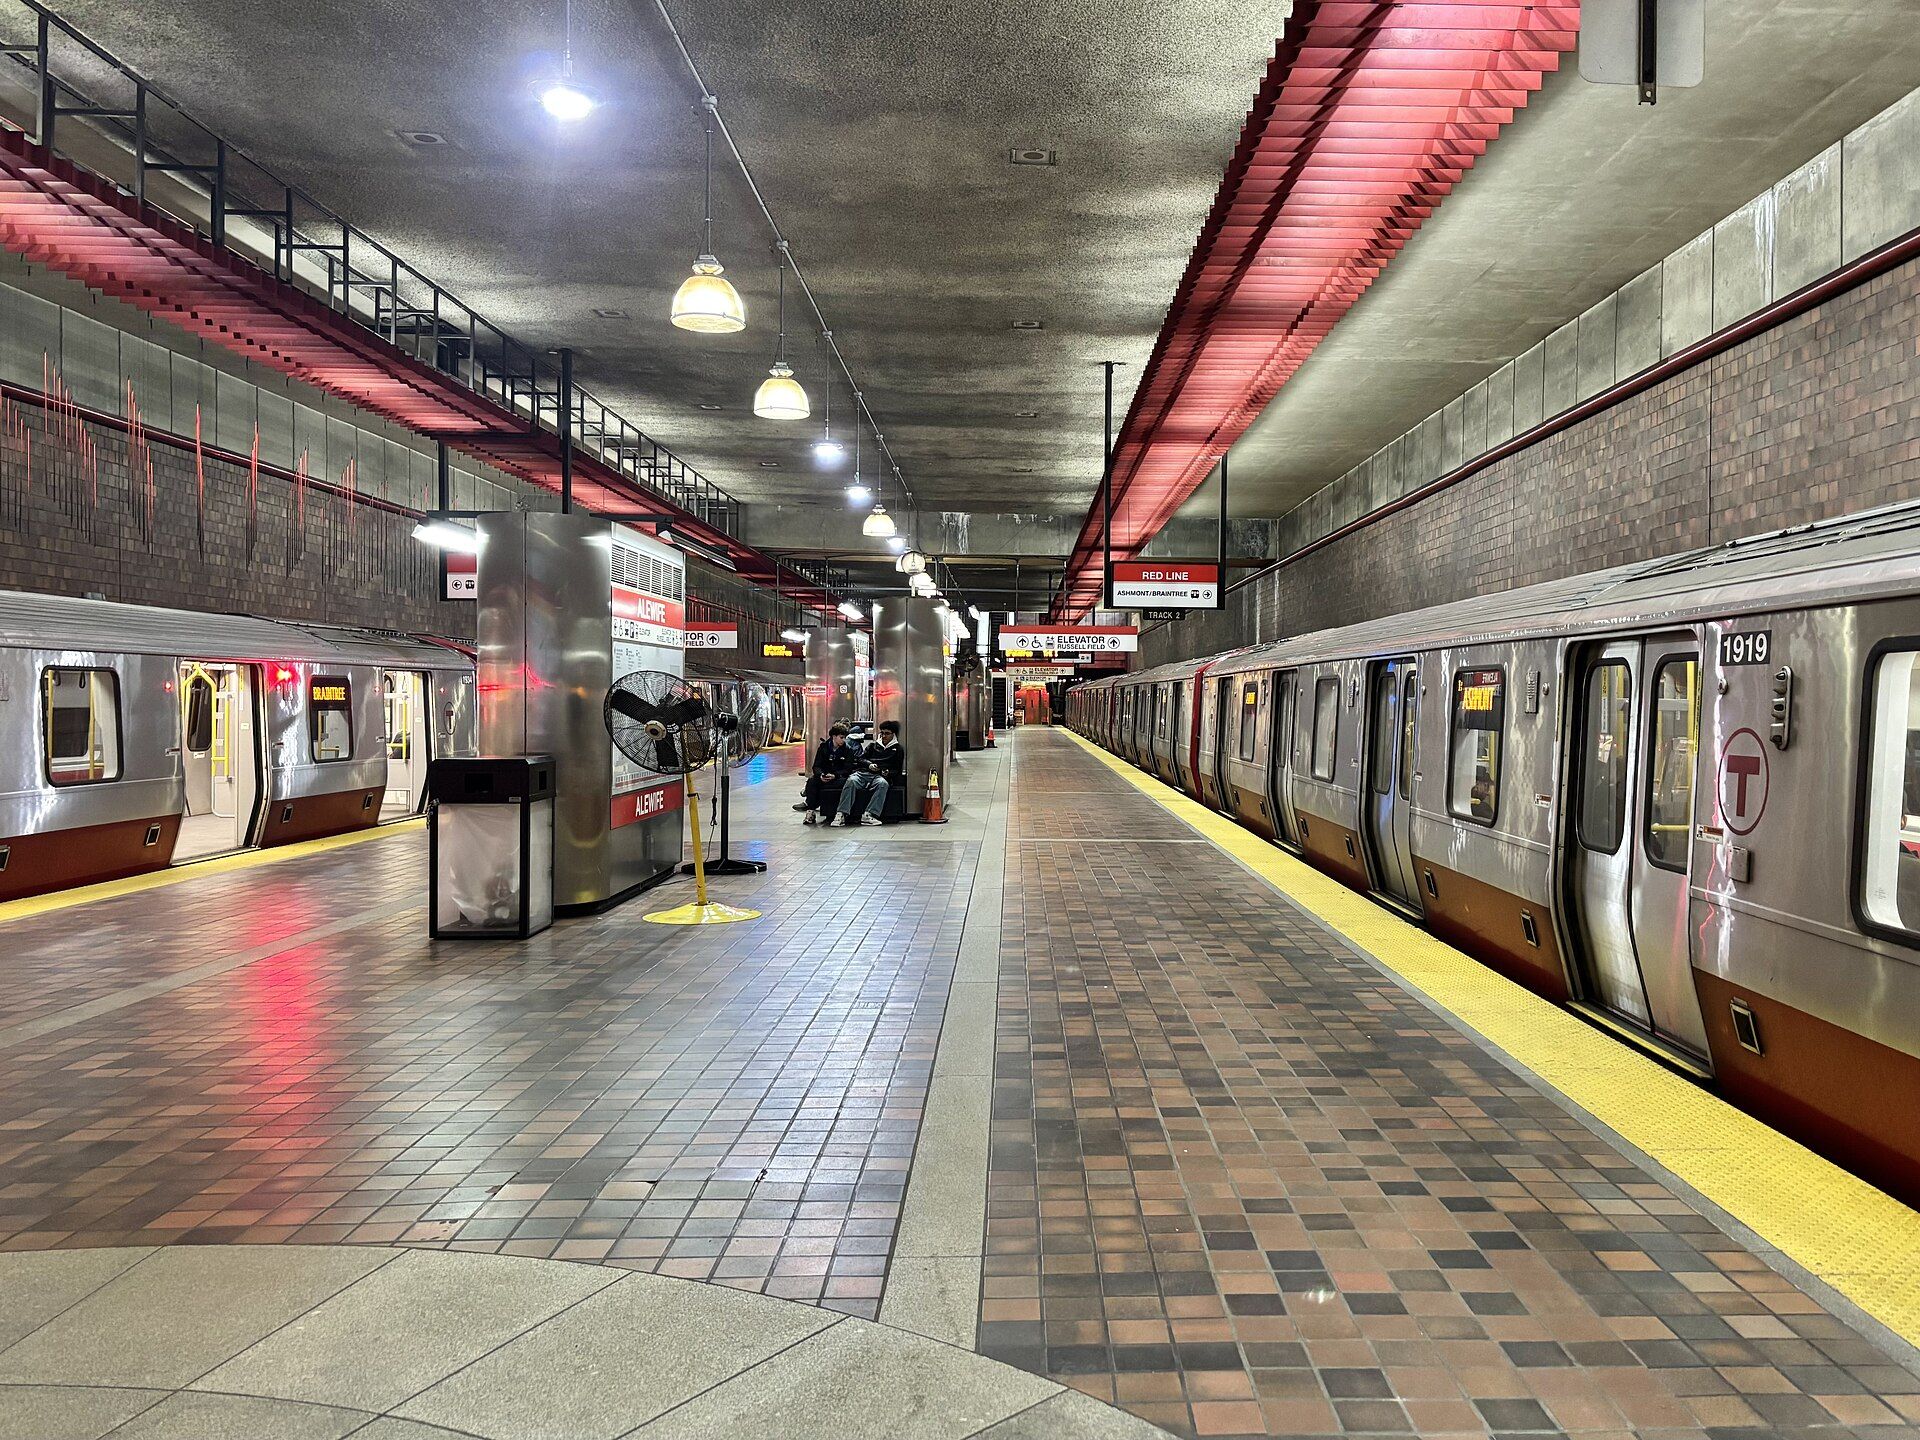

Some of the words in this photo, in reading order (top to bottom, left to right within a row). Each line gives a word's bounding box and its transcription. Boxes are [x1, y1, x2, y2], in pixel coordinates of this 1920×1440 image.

[1142, 571, 1164, 581] RED
[1166, 571, 1189, 581] LINE
[637, 598, 666, 624] ALEWIFE
[1148, 611, 1173, 619] TRACK
[1175, 611, 1181, 619] 2
[1057, 635, 1105, 644] ELEVATOR
[1723, 632, 1768, 663] 1919
[312, 686, 346, 701] BRAINTREE
[1726, 754, 1761, 818] T
[635, 789, 665, 817] ALEWIFE
